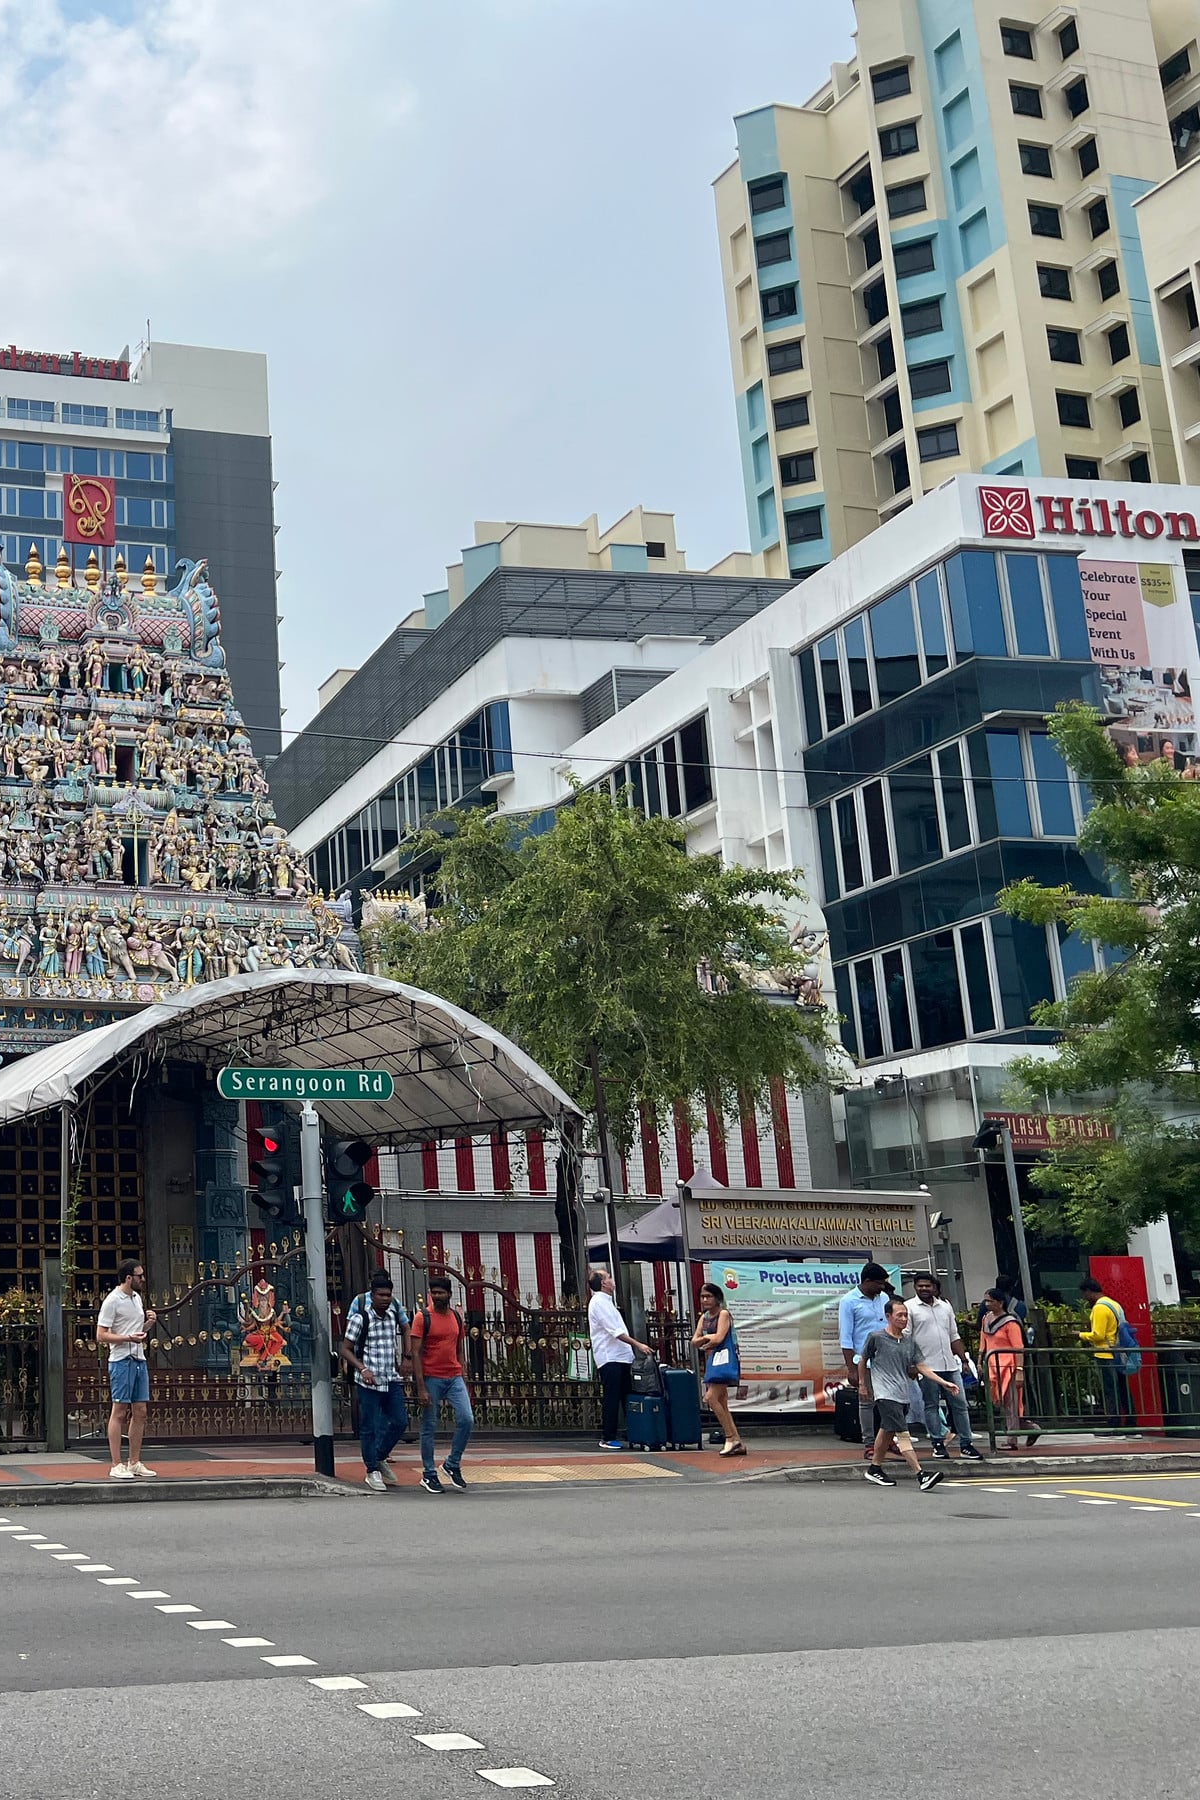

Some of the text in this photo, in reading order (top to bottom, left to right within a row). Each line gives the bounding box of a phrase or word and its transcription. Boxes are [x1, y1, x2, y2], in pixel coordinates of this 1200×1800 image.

[71, 351, 131, 380] Inn
[1035, 496, 1200, 541] Hilton
[1079, 571, 1136, 584] Celebrate
[1082, 590, 1110, 601] Your
[1086, 609, 1127, 622] Special
[1089, 628, 1122, 640] Event
[1091, 647, 1136, 660] With Us
[232, 1071, 383, 1095] Serangoon Rd
[701, 1215, 915, 1232] SRI VEERAMAKALIAMMAN TEMPLE
[702, 1235, 917, 1248] 141 SERANGOON ROAD, SINGAPORE 218042
[759, 1271, 812, 1286] Project
[814, 1271, 860, 1284] Bhakti
